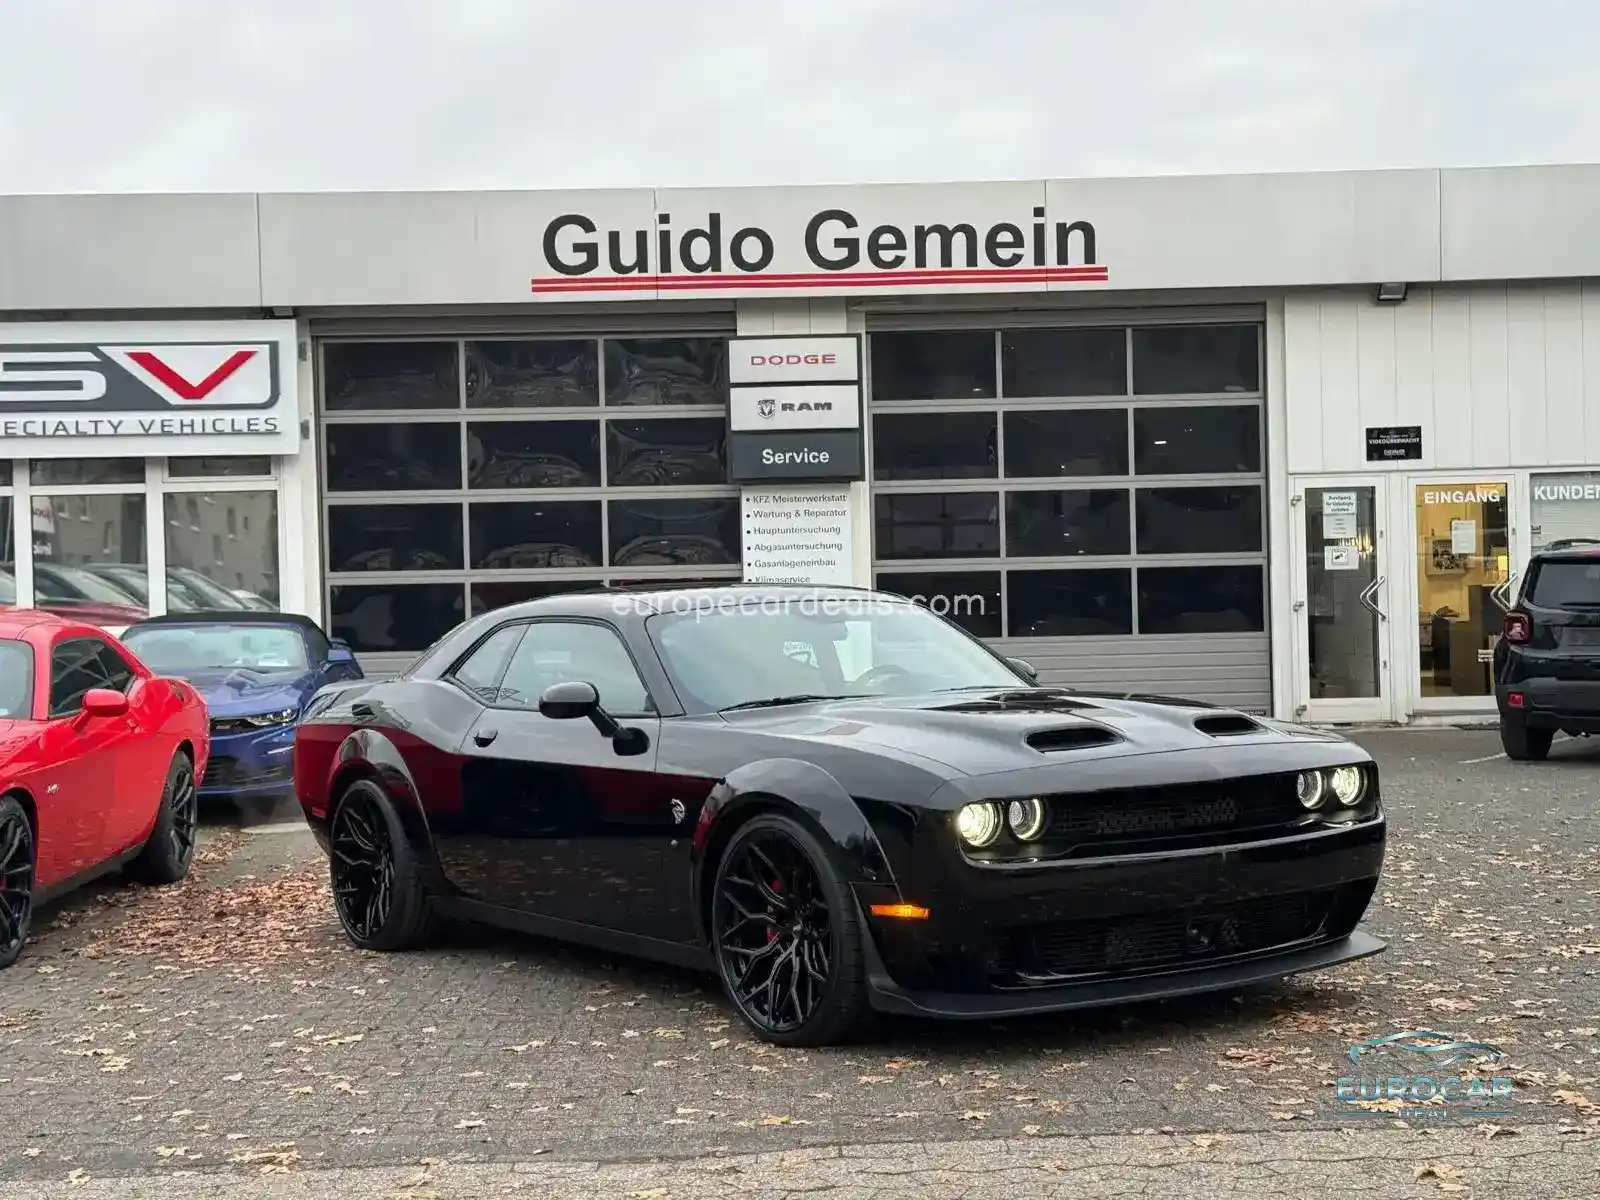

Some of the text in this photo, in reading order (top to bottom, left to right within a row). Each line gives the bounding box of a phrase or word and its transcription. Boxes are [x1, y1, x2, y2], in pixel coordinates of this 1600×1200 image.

[542, 206, 1098, 275] Guido Gemein
[750, 353, 837, 366] DODGE
[781, 402, 833, 412] RAM
[138, 417, 279, 434] VEHICLES
[761, 448, 830, 464] Service
[753, 494, 848, 503] KFZ Meisterwerkstatt
[1424, 490, 1500, 504] EINGANG
[753, 510, 792, 519] Wartung
[803, 509, 847, 518] Reparatur
[753, 526, 841, 535] Hauptuntersuchung
[754, 542, 843, 552] Abgasuntersuchung
[754, 559, 836, 568] Gasanlageneinbau
